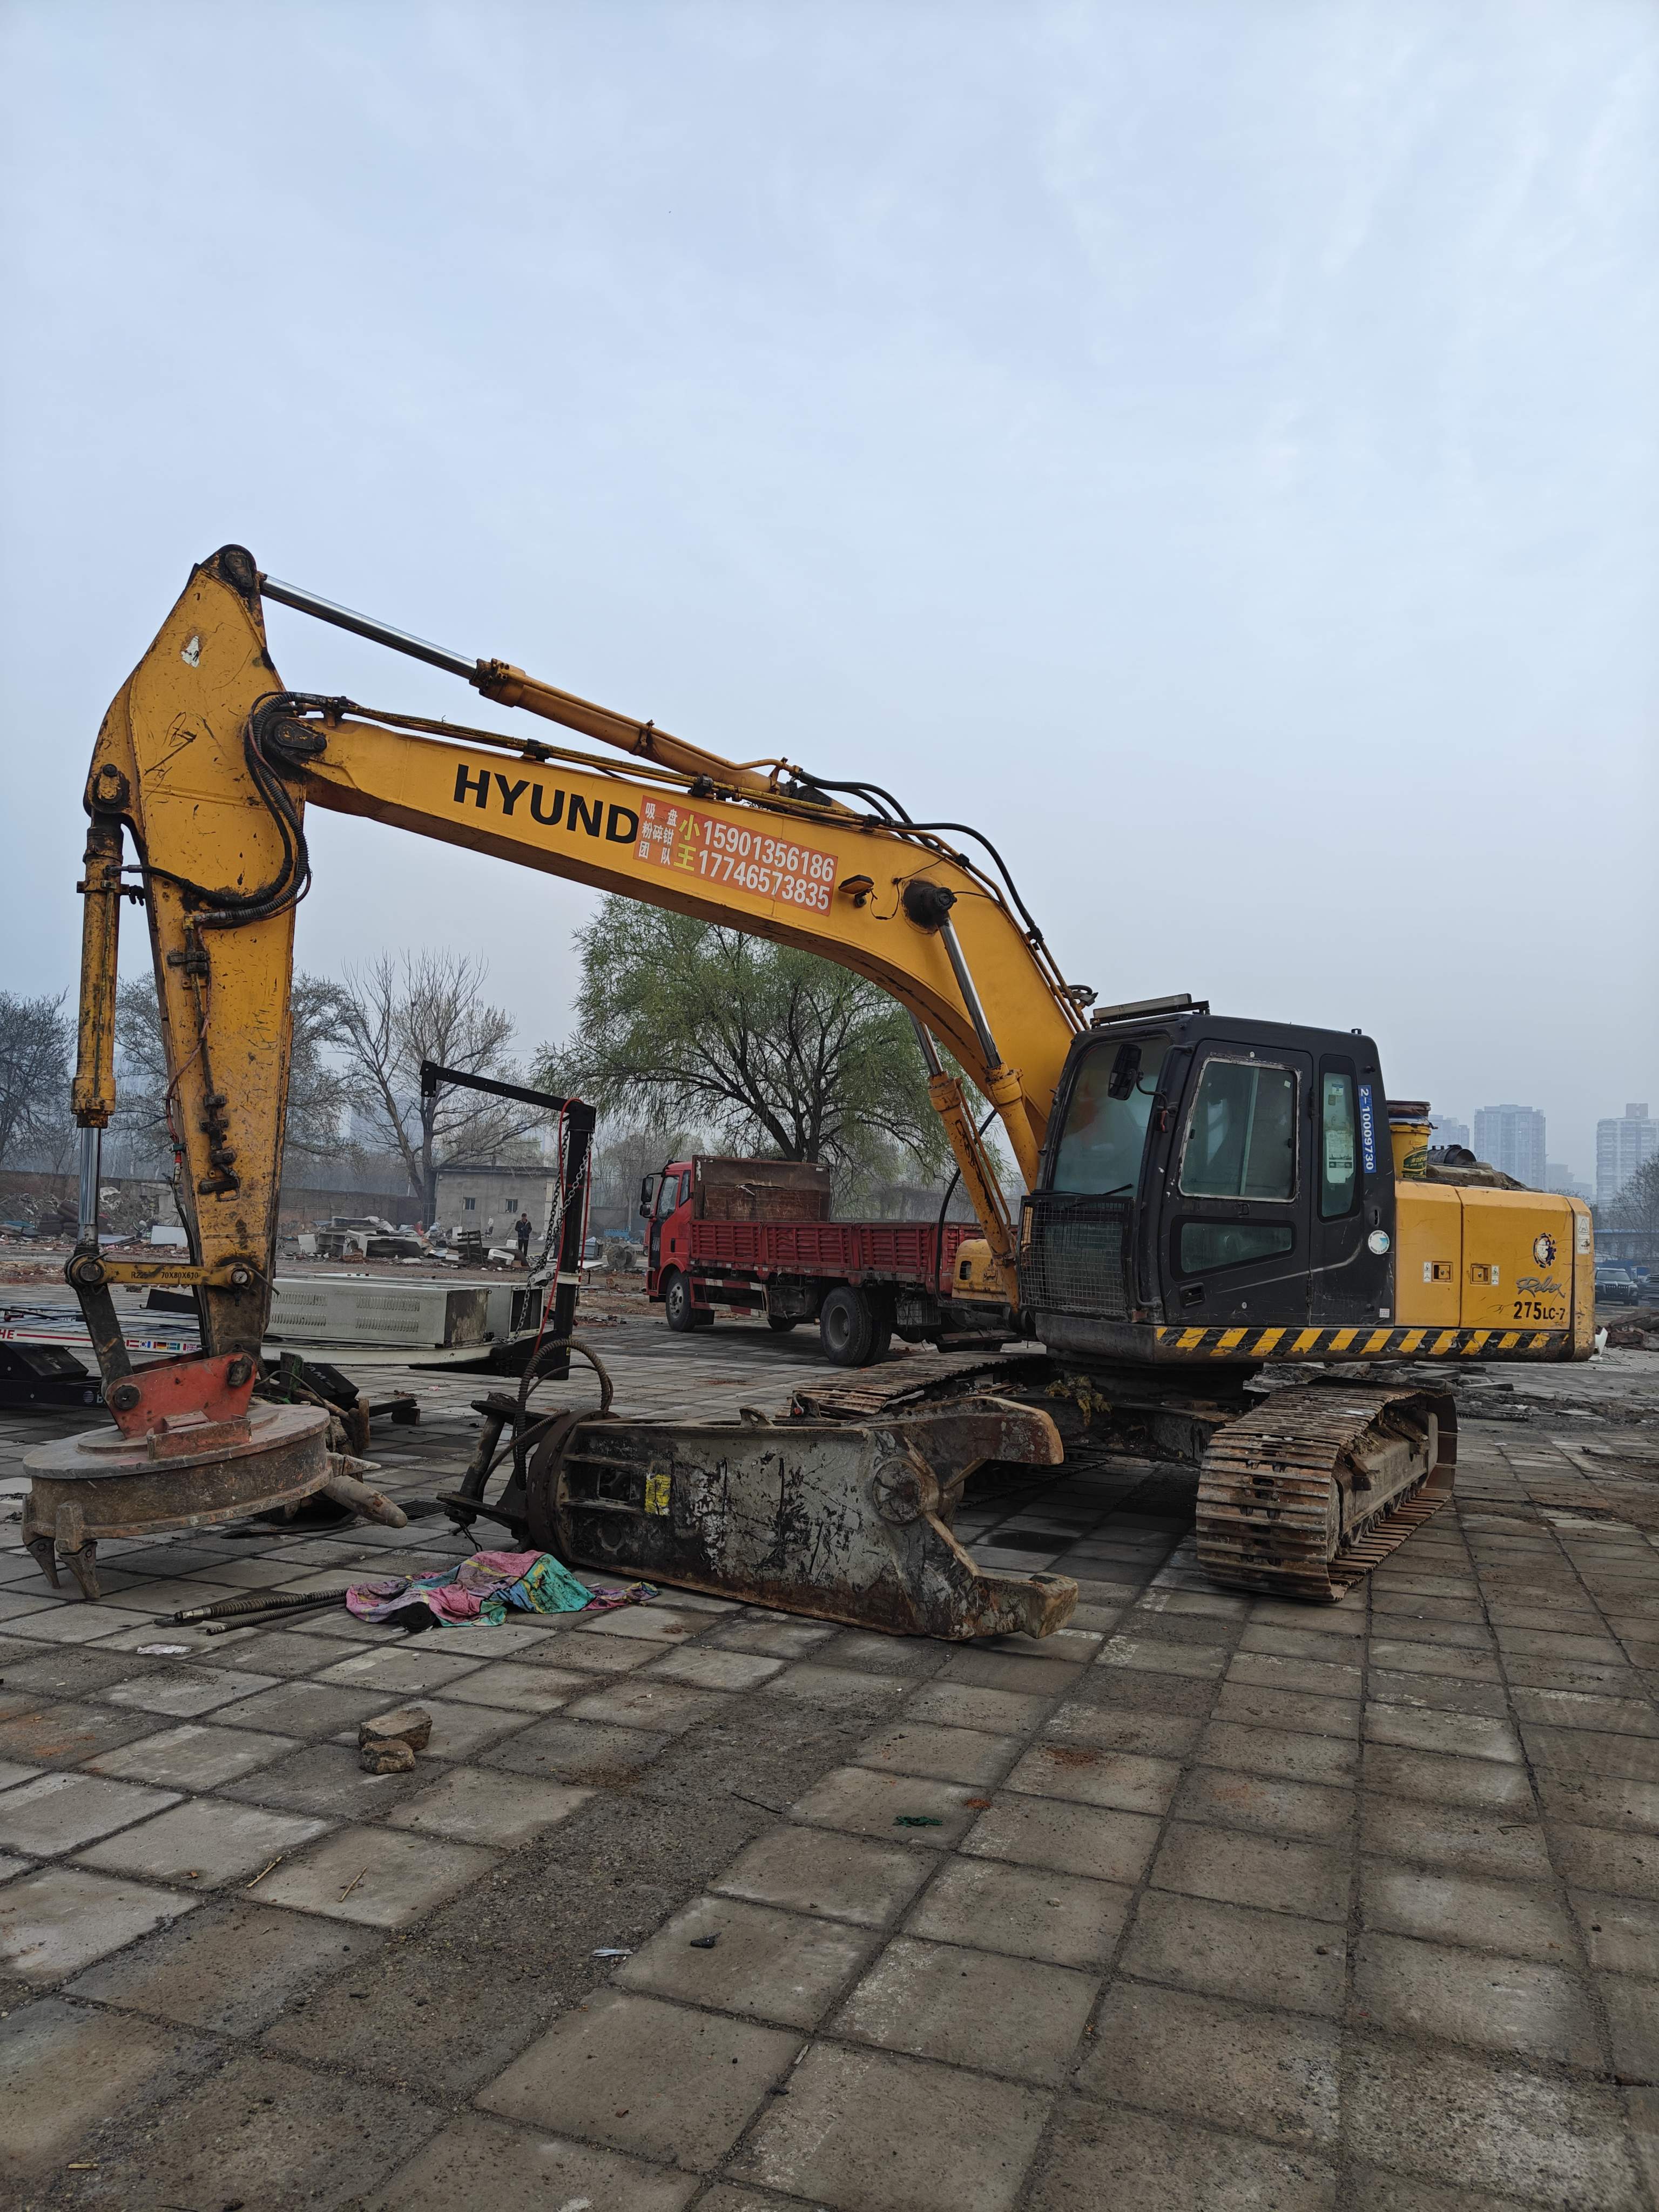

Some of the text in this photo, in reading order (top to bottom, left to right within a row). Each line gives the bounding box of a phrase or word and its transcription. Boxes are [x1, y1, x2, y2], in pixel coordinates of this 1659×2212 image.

[454, 764, 639, 844] HYUND
[642, 820, 674, 846] 粉碎钳
[699, 849, 830, 911] 17746573835
[704, 820, 834, 882] 15901356186
[1360, 1088, 1374, 1170] 2-10009730
